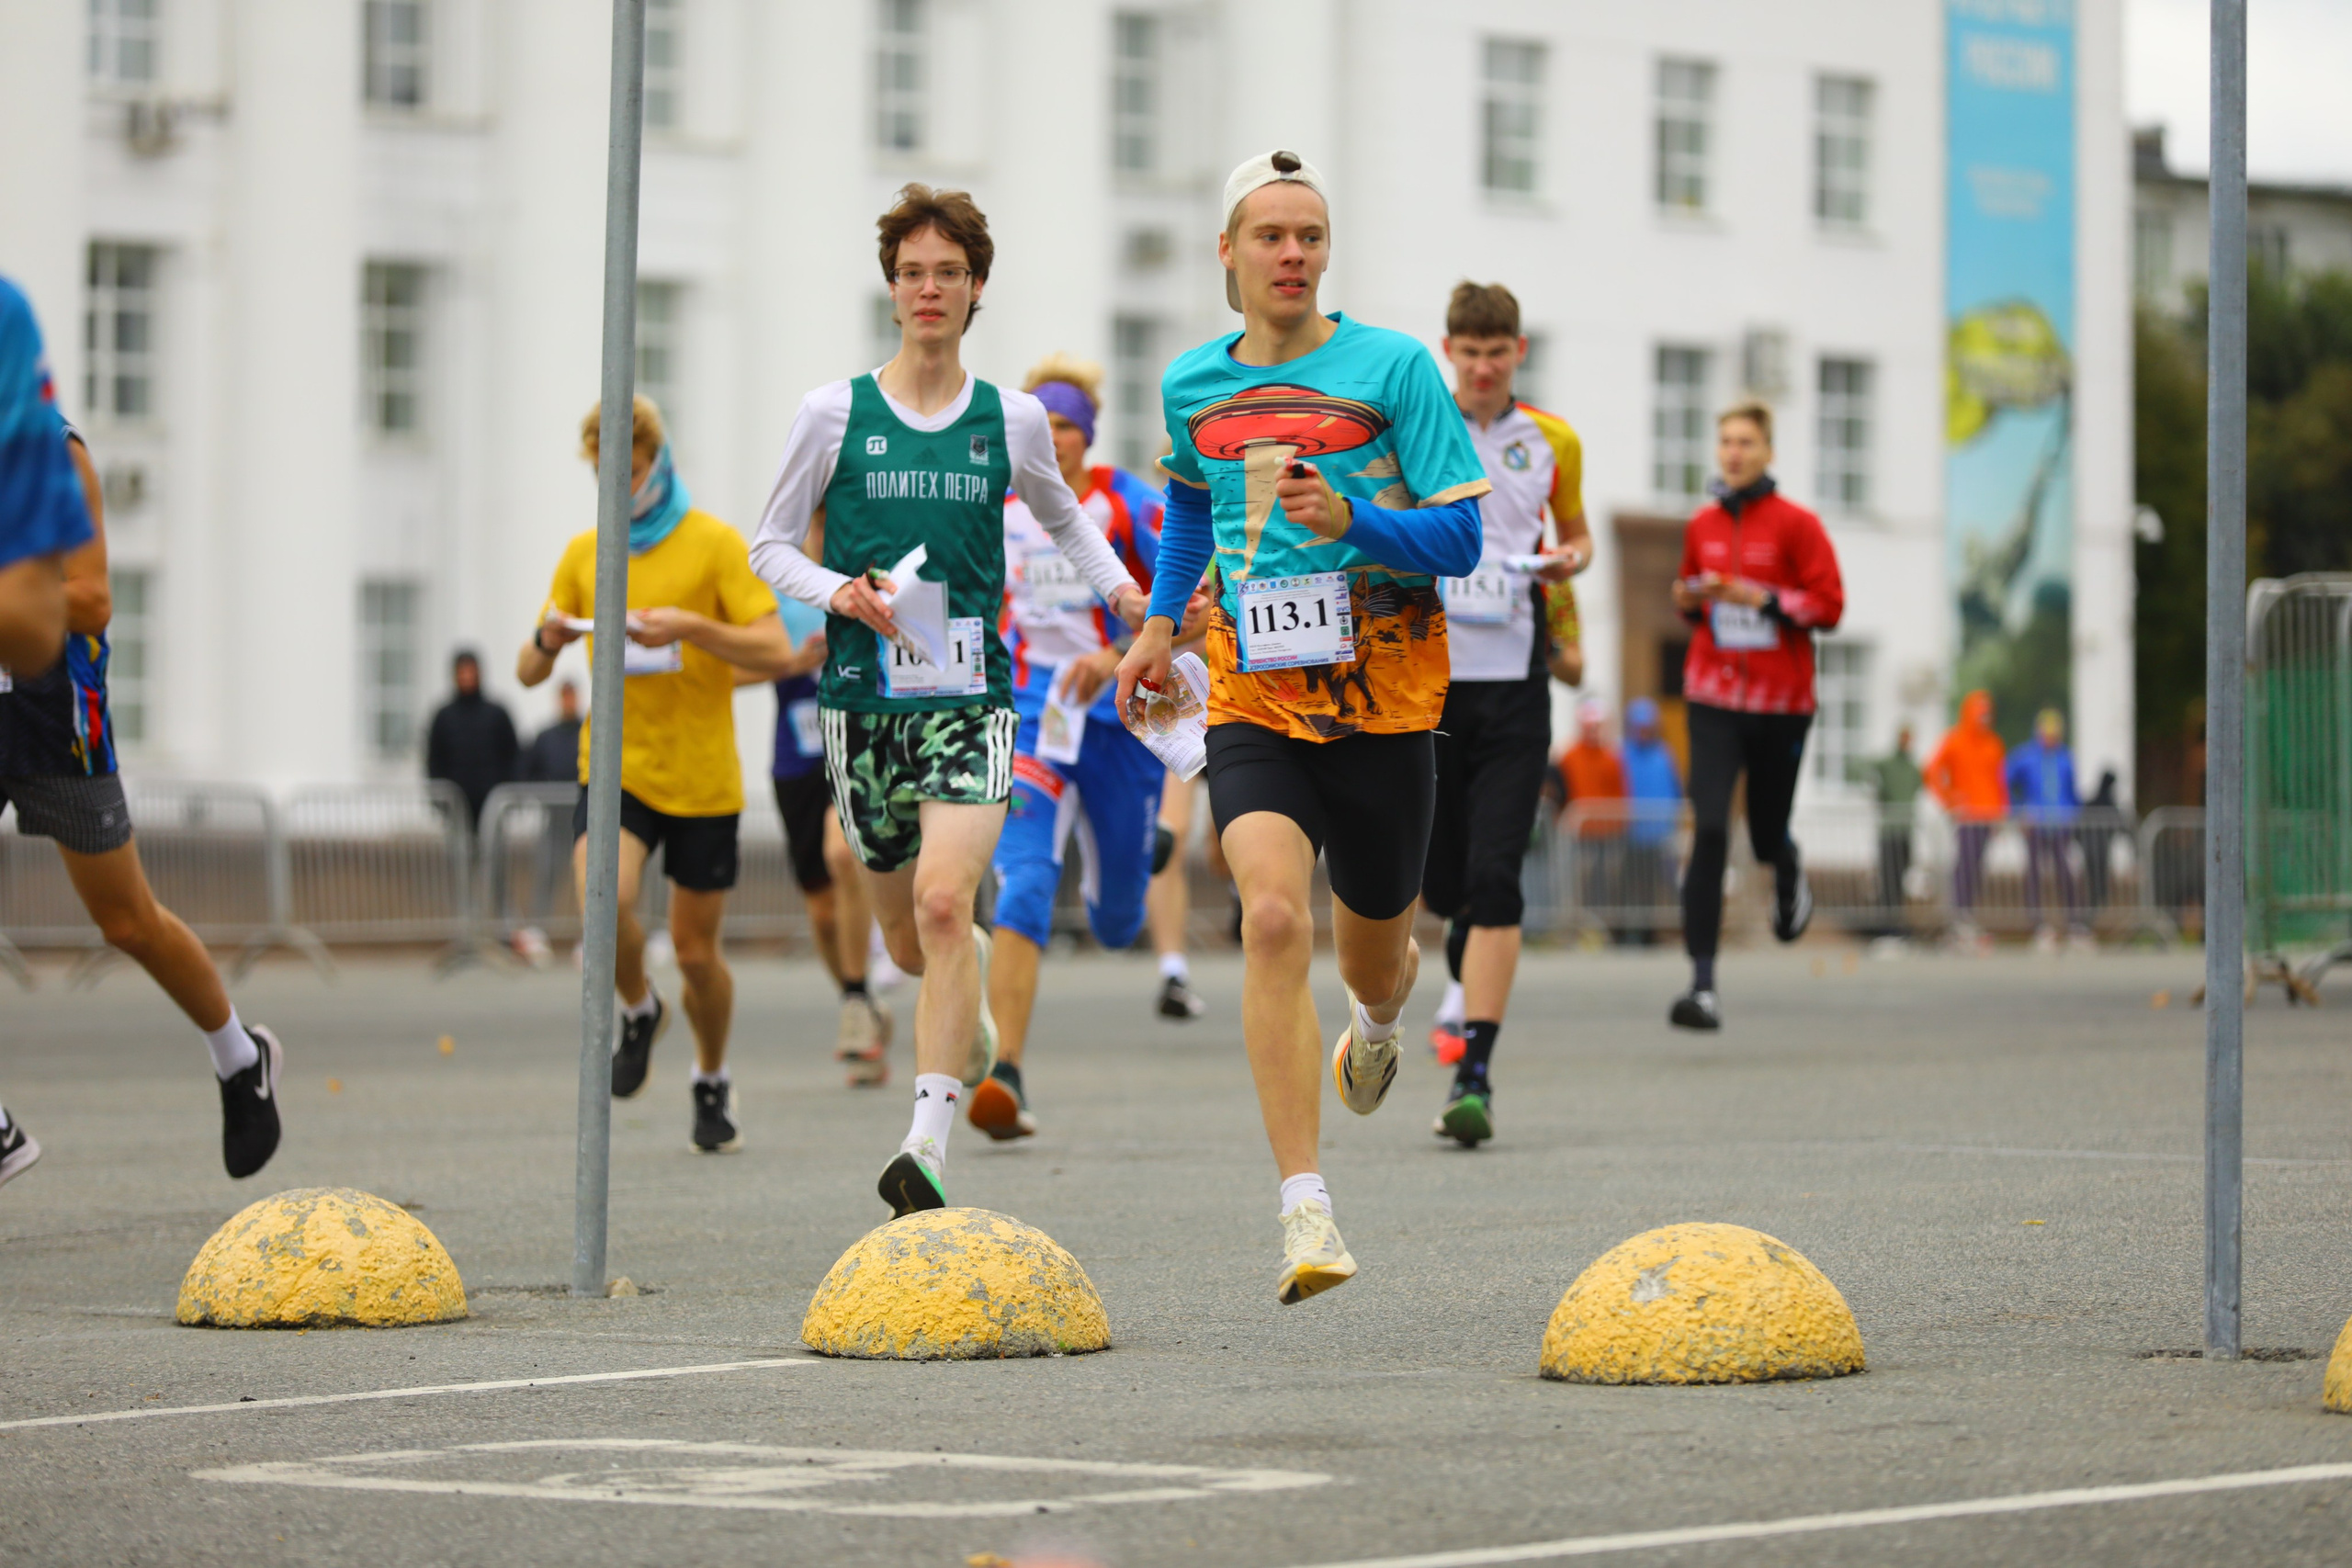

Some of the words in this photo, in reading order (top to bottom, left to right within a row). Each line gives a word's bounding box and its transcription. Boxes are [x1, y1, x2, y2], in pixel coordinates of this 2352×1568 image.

[865, 470, 939, 500] ПОЛИТЕХ
[944, 472, 989, 504] ПЕТРА
[1249, 598, 1330, 634] 113.1
